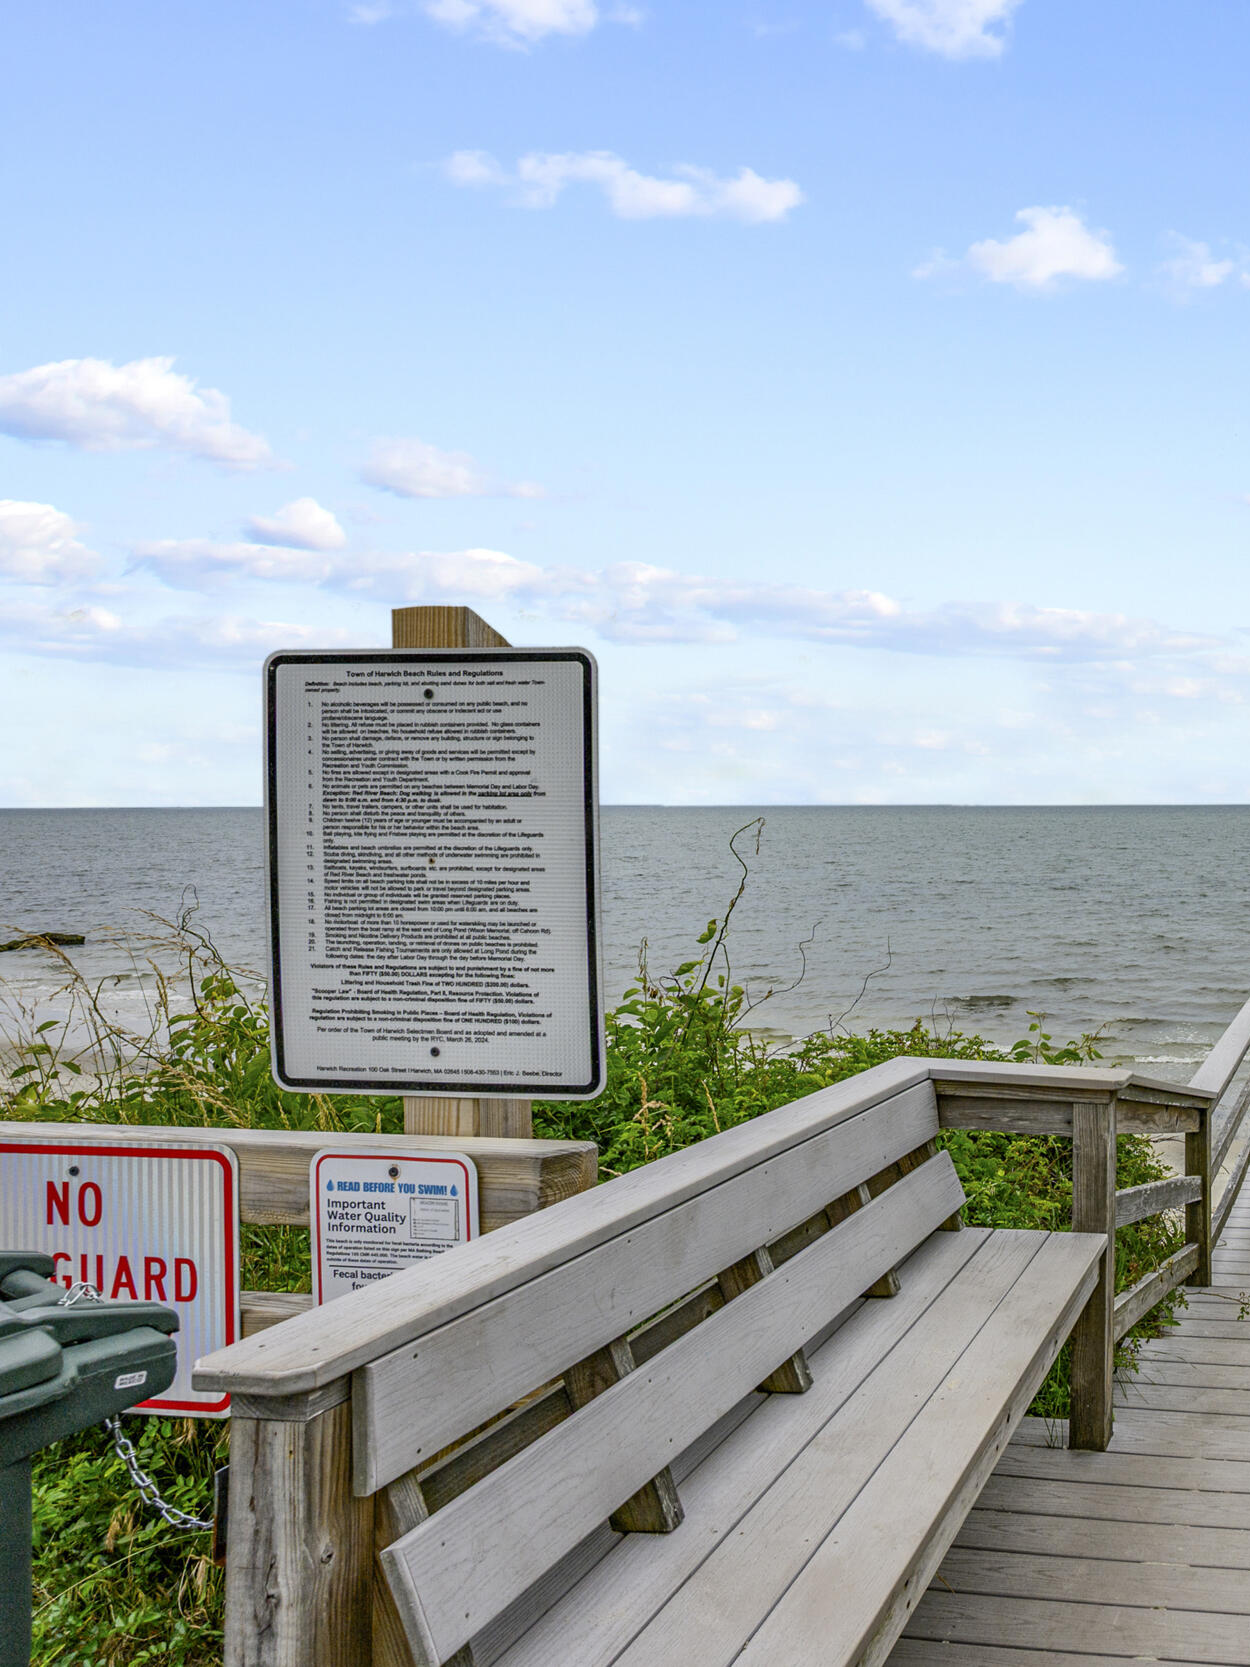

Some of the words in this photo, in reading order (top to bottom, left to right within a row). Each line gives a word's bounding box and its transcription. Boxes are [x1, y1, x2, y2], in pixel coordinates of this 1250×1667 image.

[462, 670, 503, 678] Regulations
[337, 1181, 360, 1192] READ
[363, 1182, 395, 1193] BEFORE
[398, 1183, 415, 1194] YOU
[418, 1184, 447, 1196] SWIM!
[46, 1181, 103, 1228] NO
[327, 1198, 386, 1210] Important
[327, 1210, 361, 1221] Water
[364, 1212, 406, 1225] Quality
[328, 1222, 396, 1234] Information
[333, 1269, 358, 1279] Fecal
